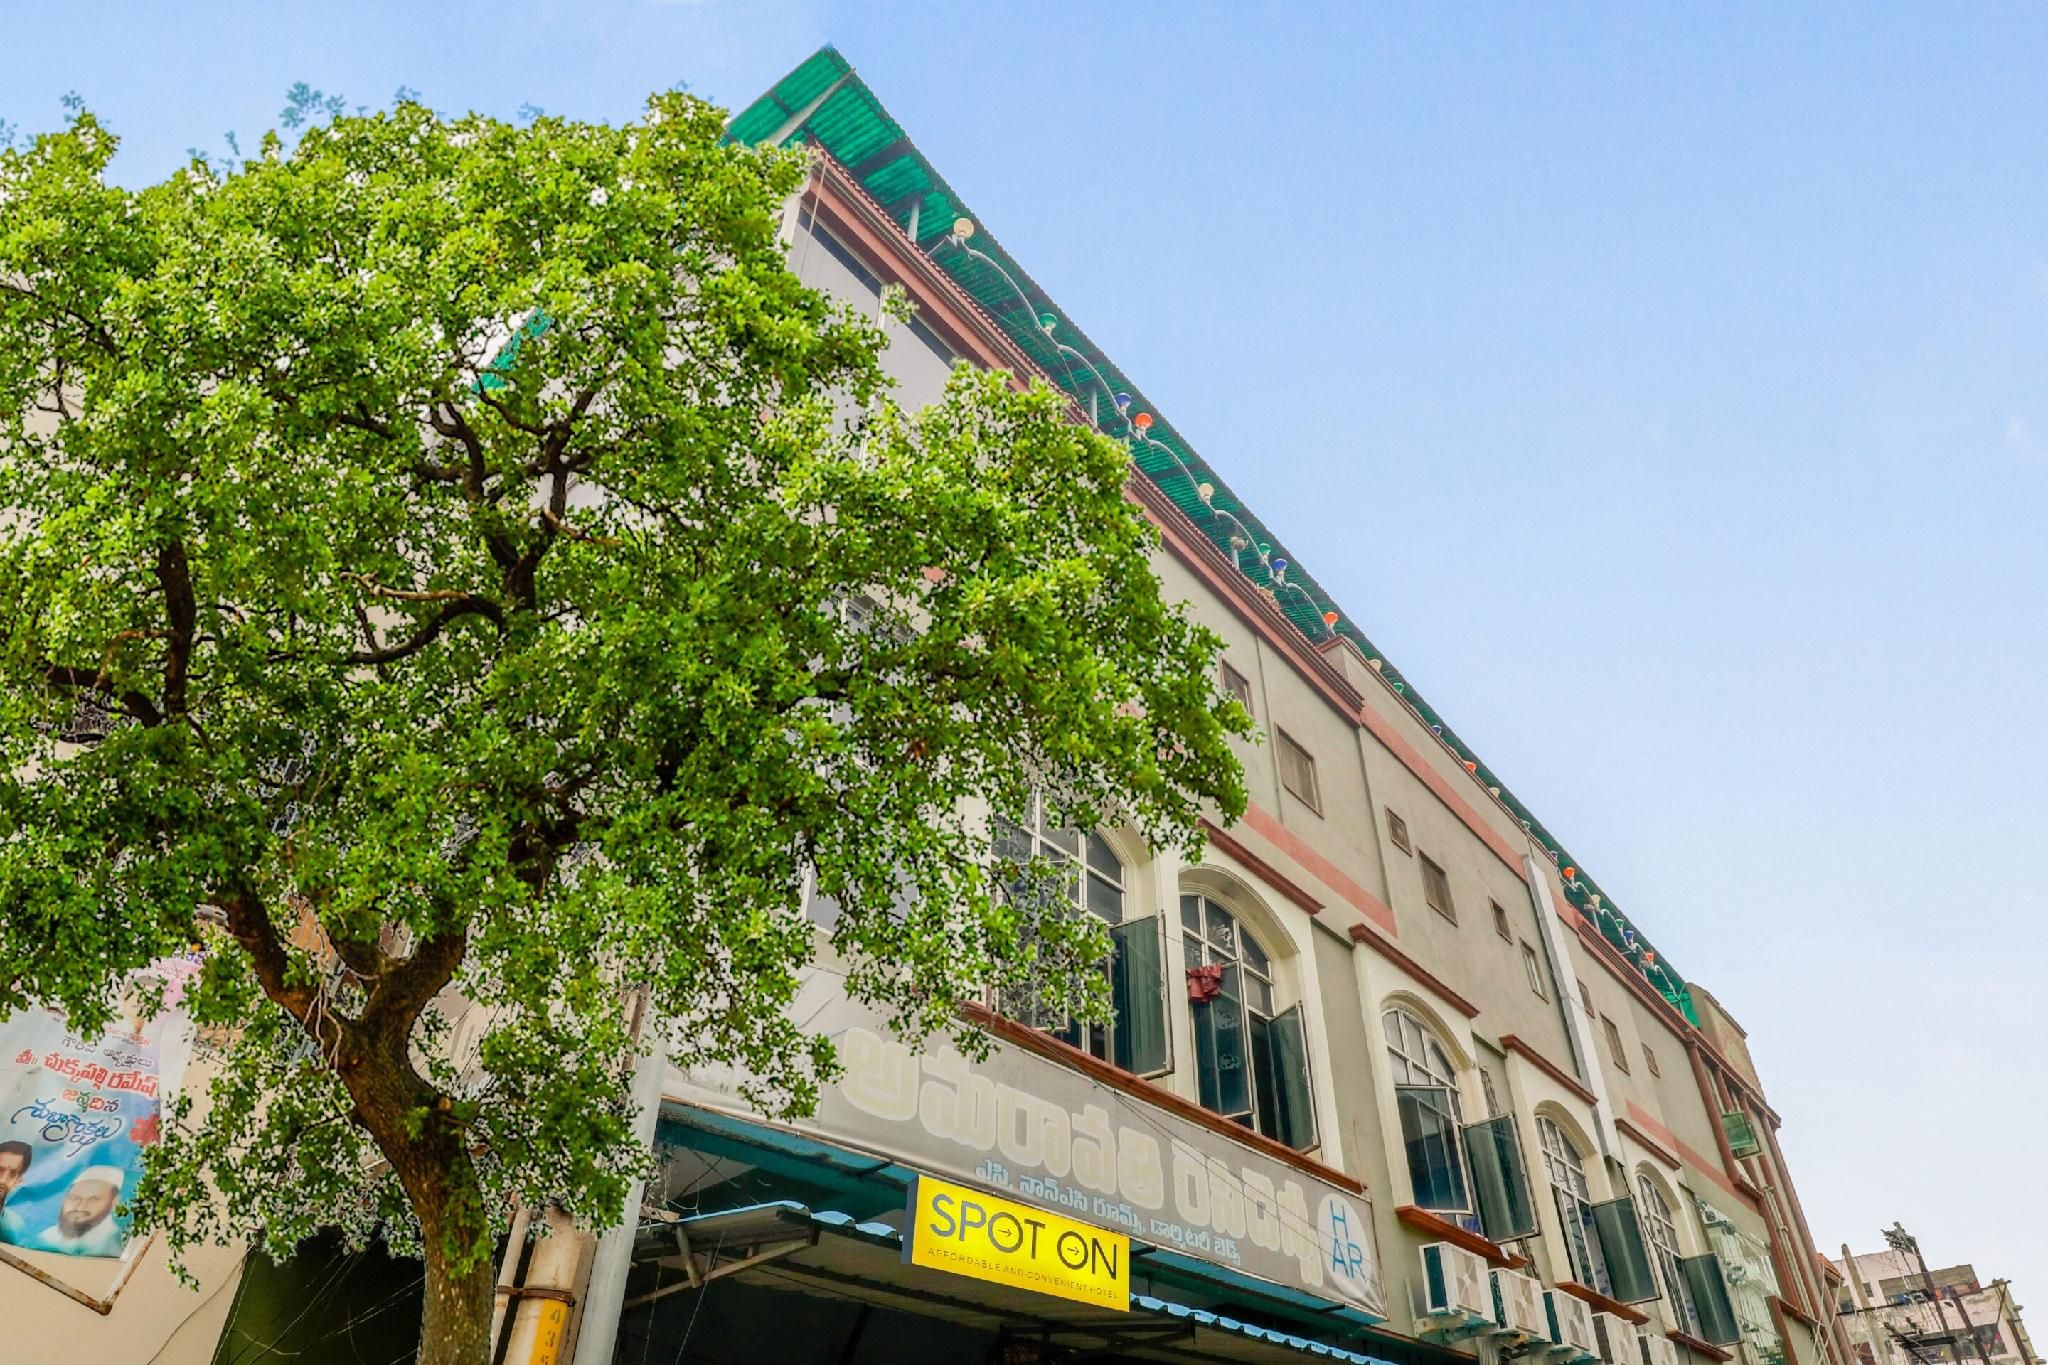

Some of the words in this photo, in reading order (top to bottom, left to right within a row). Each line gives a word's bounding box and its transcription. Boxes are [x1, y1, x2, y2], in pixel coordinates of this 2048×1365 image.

[841, 1027, 1164, 1209] అమరావతి
[928, 1248, 1001, 1271] AFFORDABLE
[1004, 1265, 1024, 1277] AND
[1027, 1271, 1088, 1292] CONVENIENT
[930, 1193, 1045, 1260] SPOT
[1057, 1231, 1117, 1280] ON
